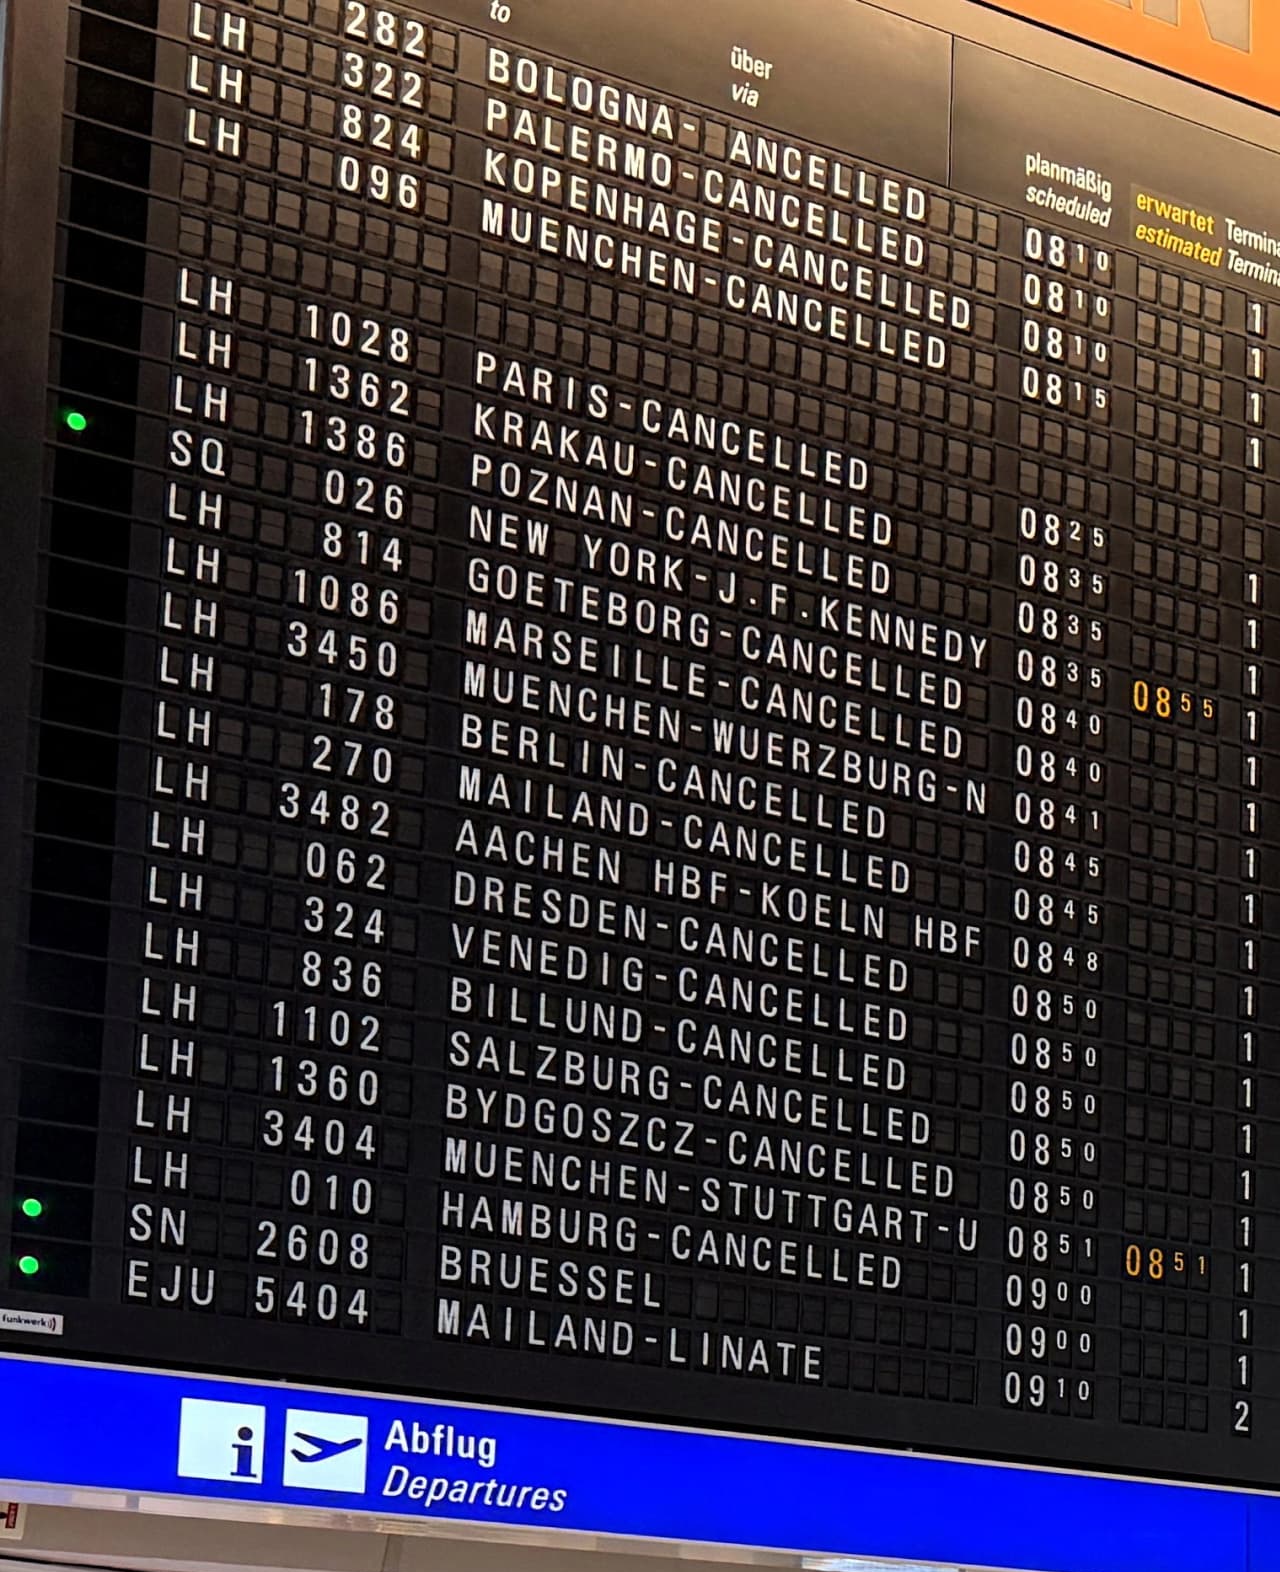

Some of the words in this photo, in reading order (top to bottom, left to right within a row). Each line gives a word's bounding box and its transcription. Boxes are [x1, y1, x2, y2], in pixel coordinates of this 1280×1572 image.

[193, 3, 245, 51] LH
[345, 1, 425, 57] 282
[489, 0, 511, 23] to
[731, 46, 773, 80] über
[732, 83, 759, 108] via
[487, 98, 923, 267] PALERMO-CANCELLED
[1026, 152, 1112, 203] planmäßig
[1026, 184, 1112, 228] scheduled
[1137, 192, 1215, 235] erwartet
[340, 157, 417, 208] 096
[483, 199, 945, 368] MUENCHEN-CANCELLED
[485, 148, 969, 330] KOPENHAGE-CANCELLED
[1135, 224, 1223, 267] estimated
[181, 269, 232, 314] LH
[307, 305, 408, 362] 1028
[477, 352, 867, 489] PARIS-CANCELLED
[171, 431, 224, 475] SQ
[326, 470, 402, 519] 026
[471, 506, 548, 555] NEW
[472, 455, 889, 593] POZNAN-CANCELLED
[475, 403, 891, 545] KRAKAU-CANCELLED
[467, 610, 961, 758] MARSEILLE-CANCELLED
[469, 559, 961, 709] GOETEBORG-CANCELLED
[463, 714, 884, 837] BERLIN-CANCELLED
[465, 662, 985, 813] MUENCHEN-WUERZBURG-N
[460, 766, 908, 892] MAILAND-CANCELLED
[455, 872, 906, 991] DRESDEN-CANCELLED
[456, 820, 619, 883] AACHEN
[655, 860, 882, 938] HBF-KOELN
[916, 916, 979, 956] HBF
[452, 978, 904, 1090] BILLUND-CANCELLED
[453, 924, 906, 1040] VENEDIG-CANCELLED
[447, 1085, 952, 1196] BYDGOSZCZ-CANCELLED
[450, 1032, 928, 1143] SALZBURG-CANCELLED
[443, 1192, 900, 1288] HAMBURG-CANCELLED
[446, 1138, 976, 1250] MUENCHEN-STUTTGART-U
[130, 1205, 185, 1244] SN
[258, 1222, 367, 1268] 2608
[441, 1246, 659, 1306] BRUESSEL
[129, 1261, 213, 1304] EJU
[256, 1277, 367, 1323] 5404
[439, 1299, 820, 1378] MAILAND-LINATE
[382, 1465, 567, 1512] Departures
[384, 1420, 497, 1466] Abflug
